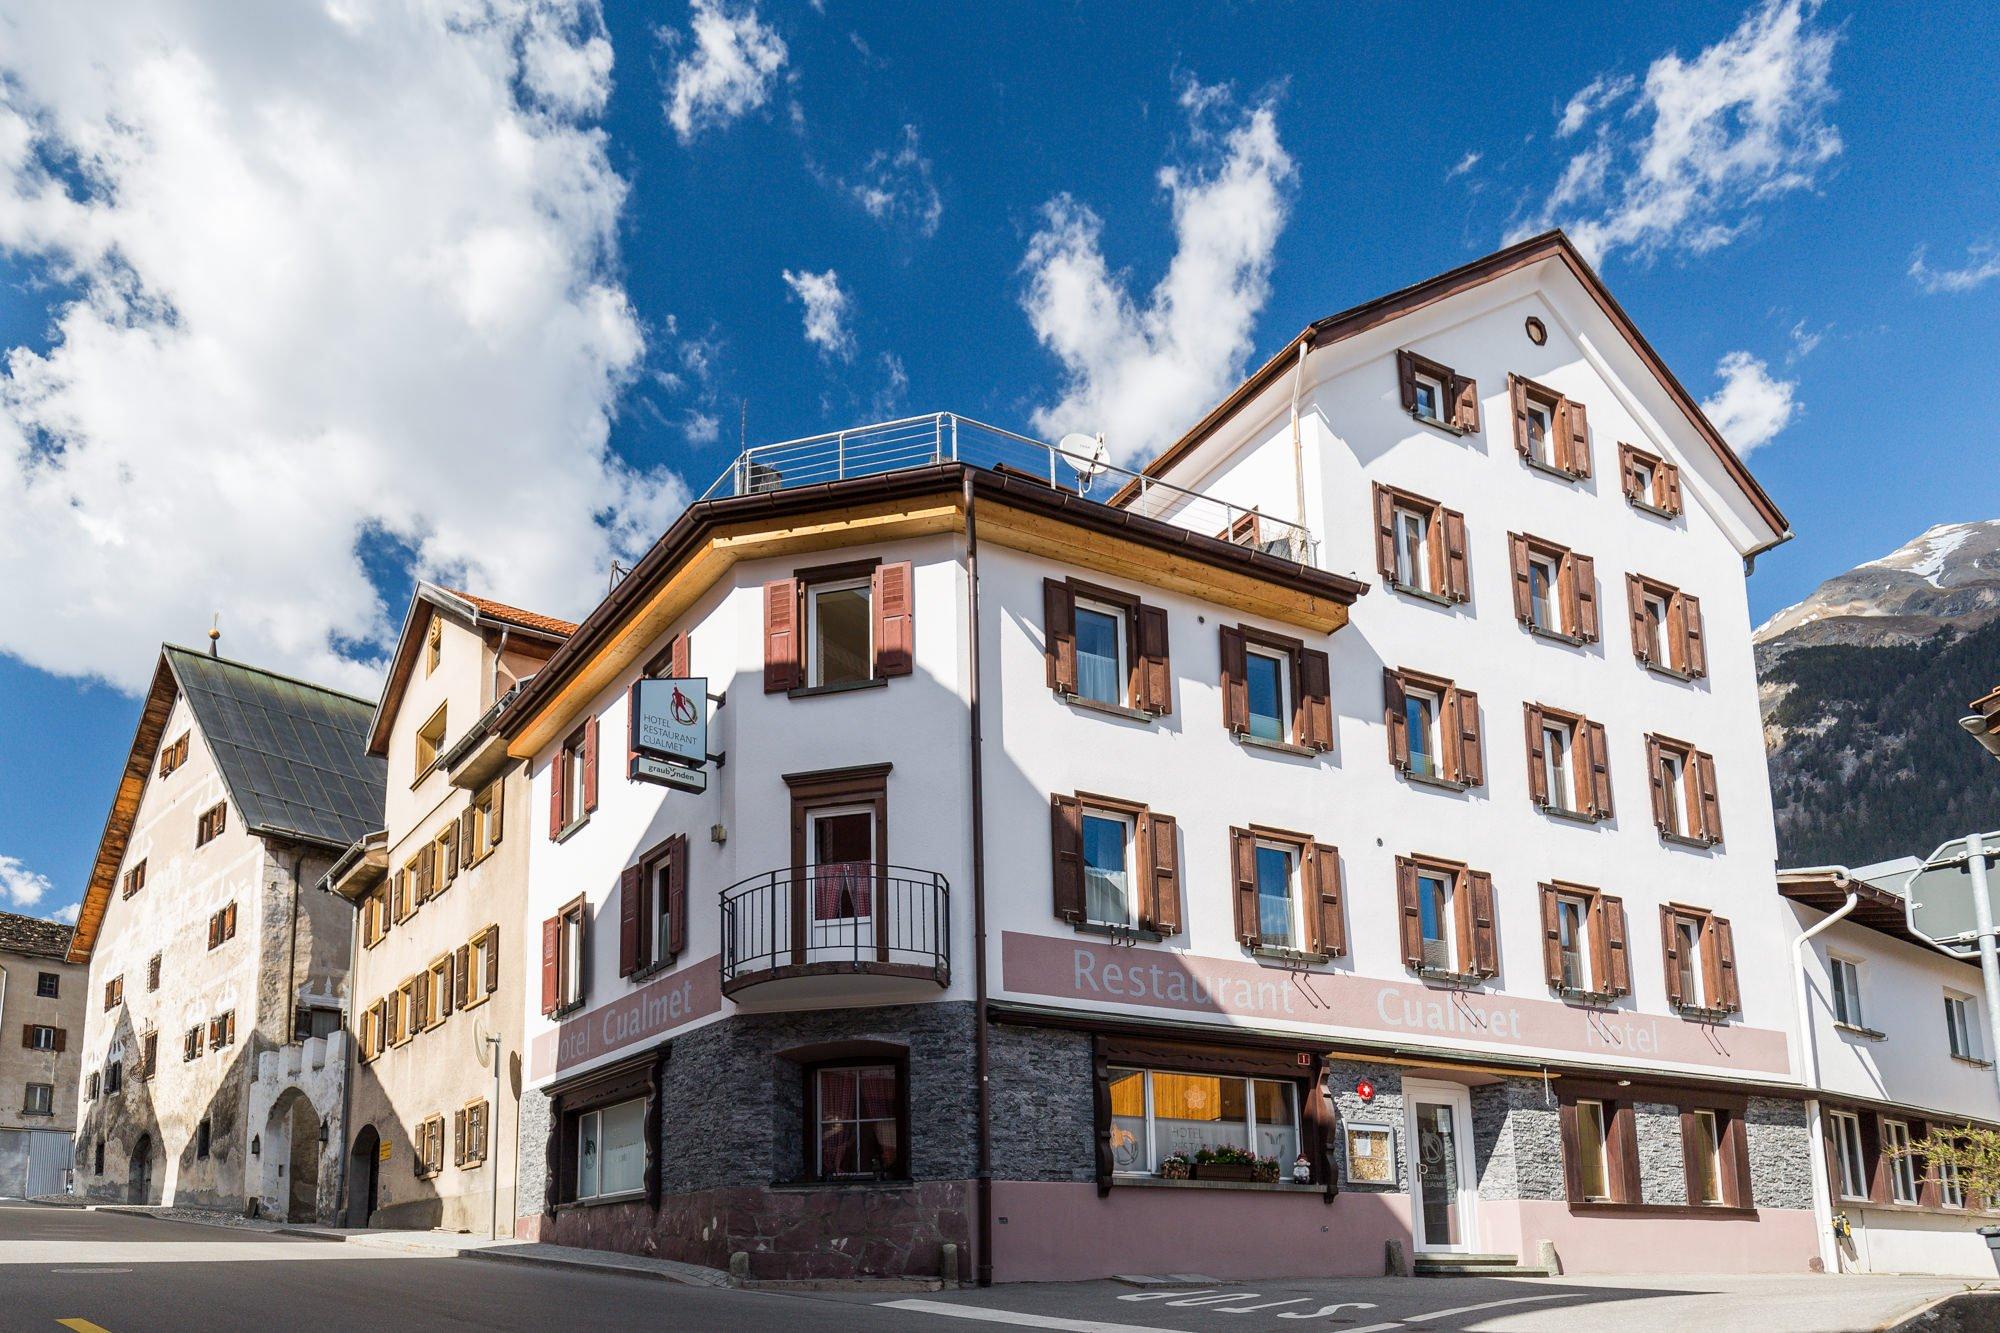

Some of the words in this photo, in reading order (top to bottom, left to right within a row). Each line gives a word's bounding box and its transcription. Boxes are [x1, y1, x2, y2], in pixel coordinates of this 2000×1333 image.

[643, 714, 671, 728] HOTEL
[643, 724, 697, 745] RESTAURANT
[643, 735, 684, 752] CUALMET
[602, 979, 693, 1045] Cualmet
[1073, 949, 1295, 1014] Restaurant
[1376, 987, 1521, 1039] Cualmet
[1586, 1013, 1659, 1054] Hotel
